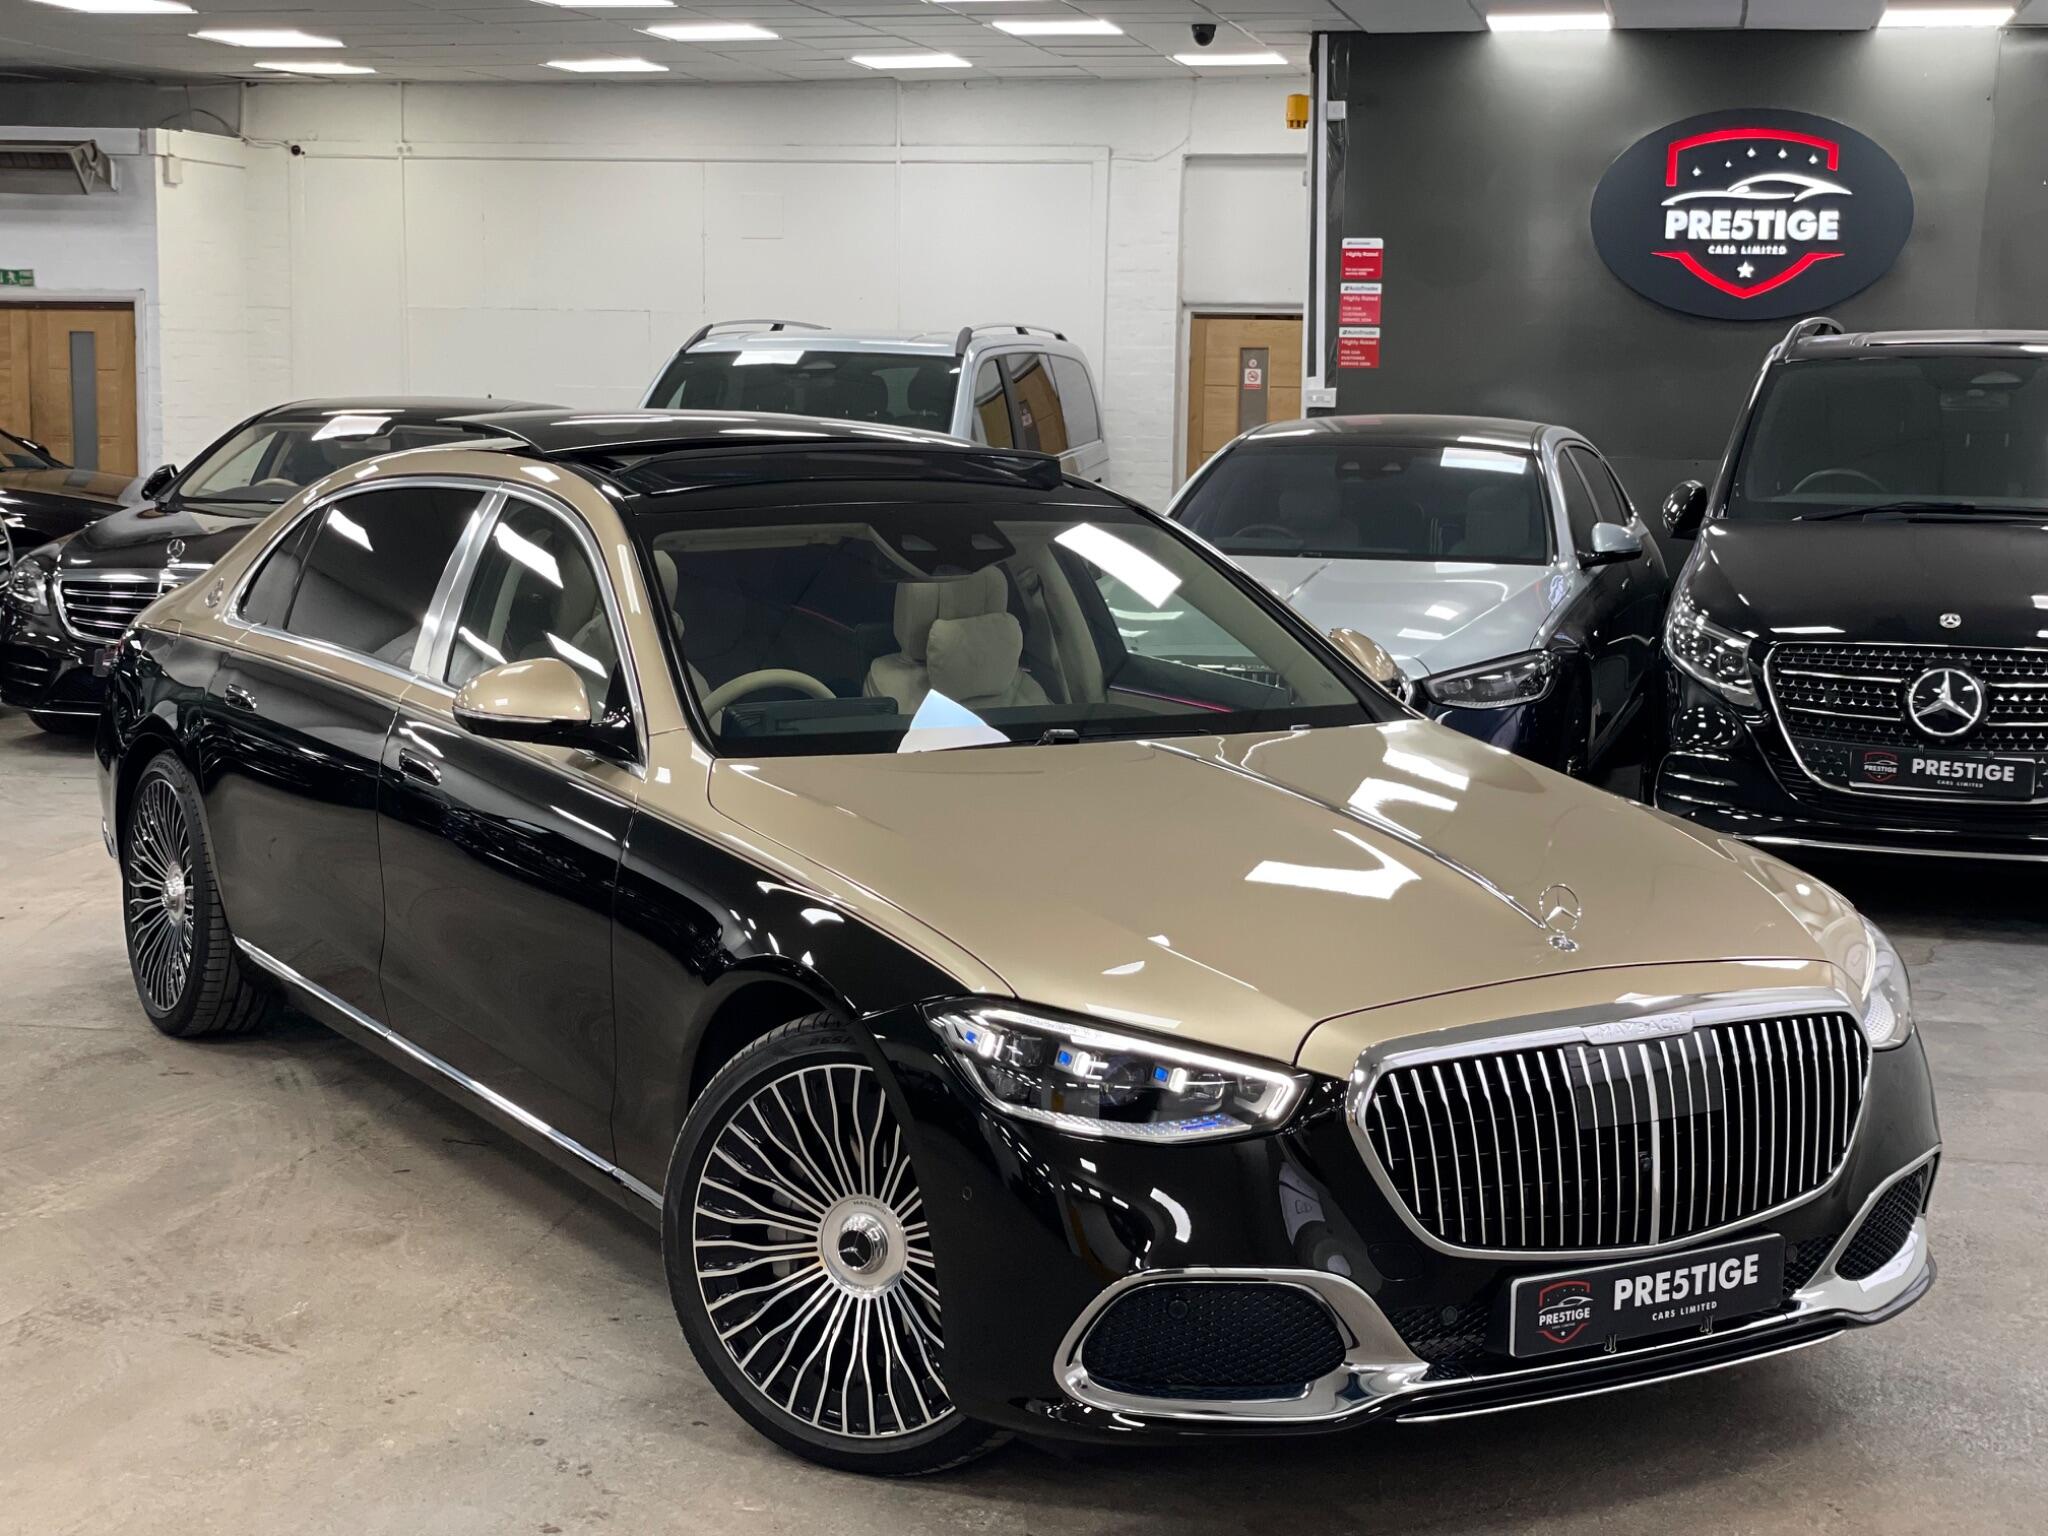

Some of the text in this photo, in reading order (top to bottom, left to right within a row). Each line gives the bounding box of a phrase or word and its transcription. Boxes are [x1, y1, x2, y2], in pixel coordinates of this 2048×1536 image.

[1708, 245, 1788, 256] CARS LIMITED
[1652, 1301, 1718, 1321] CARS LIMITED
